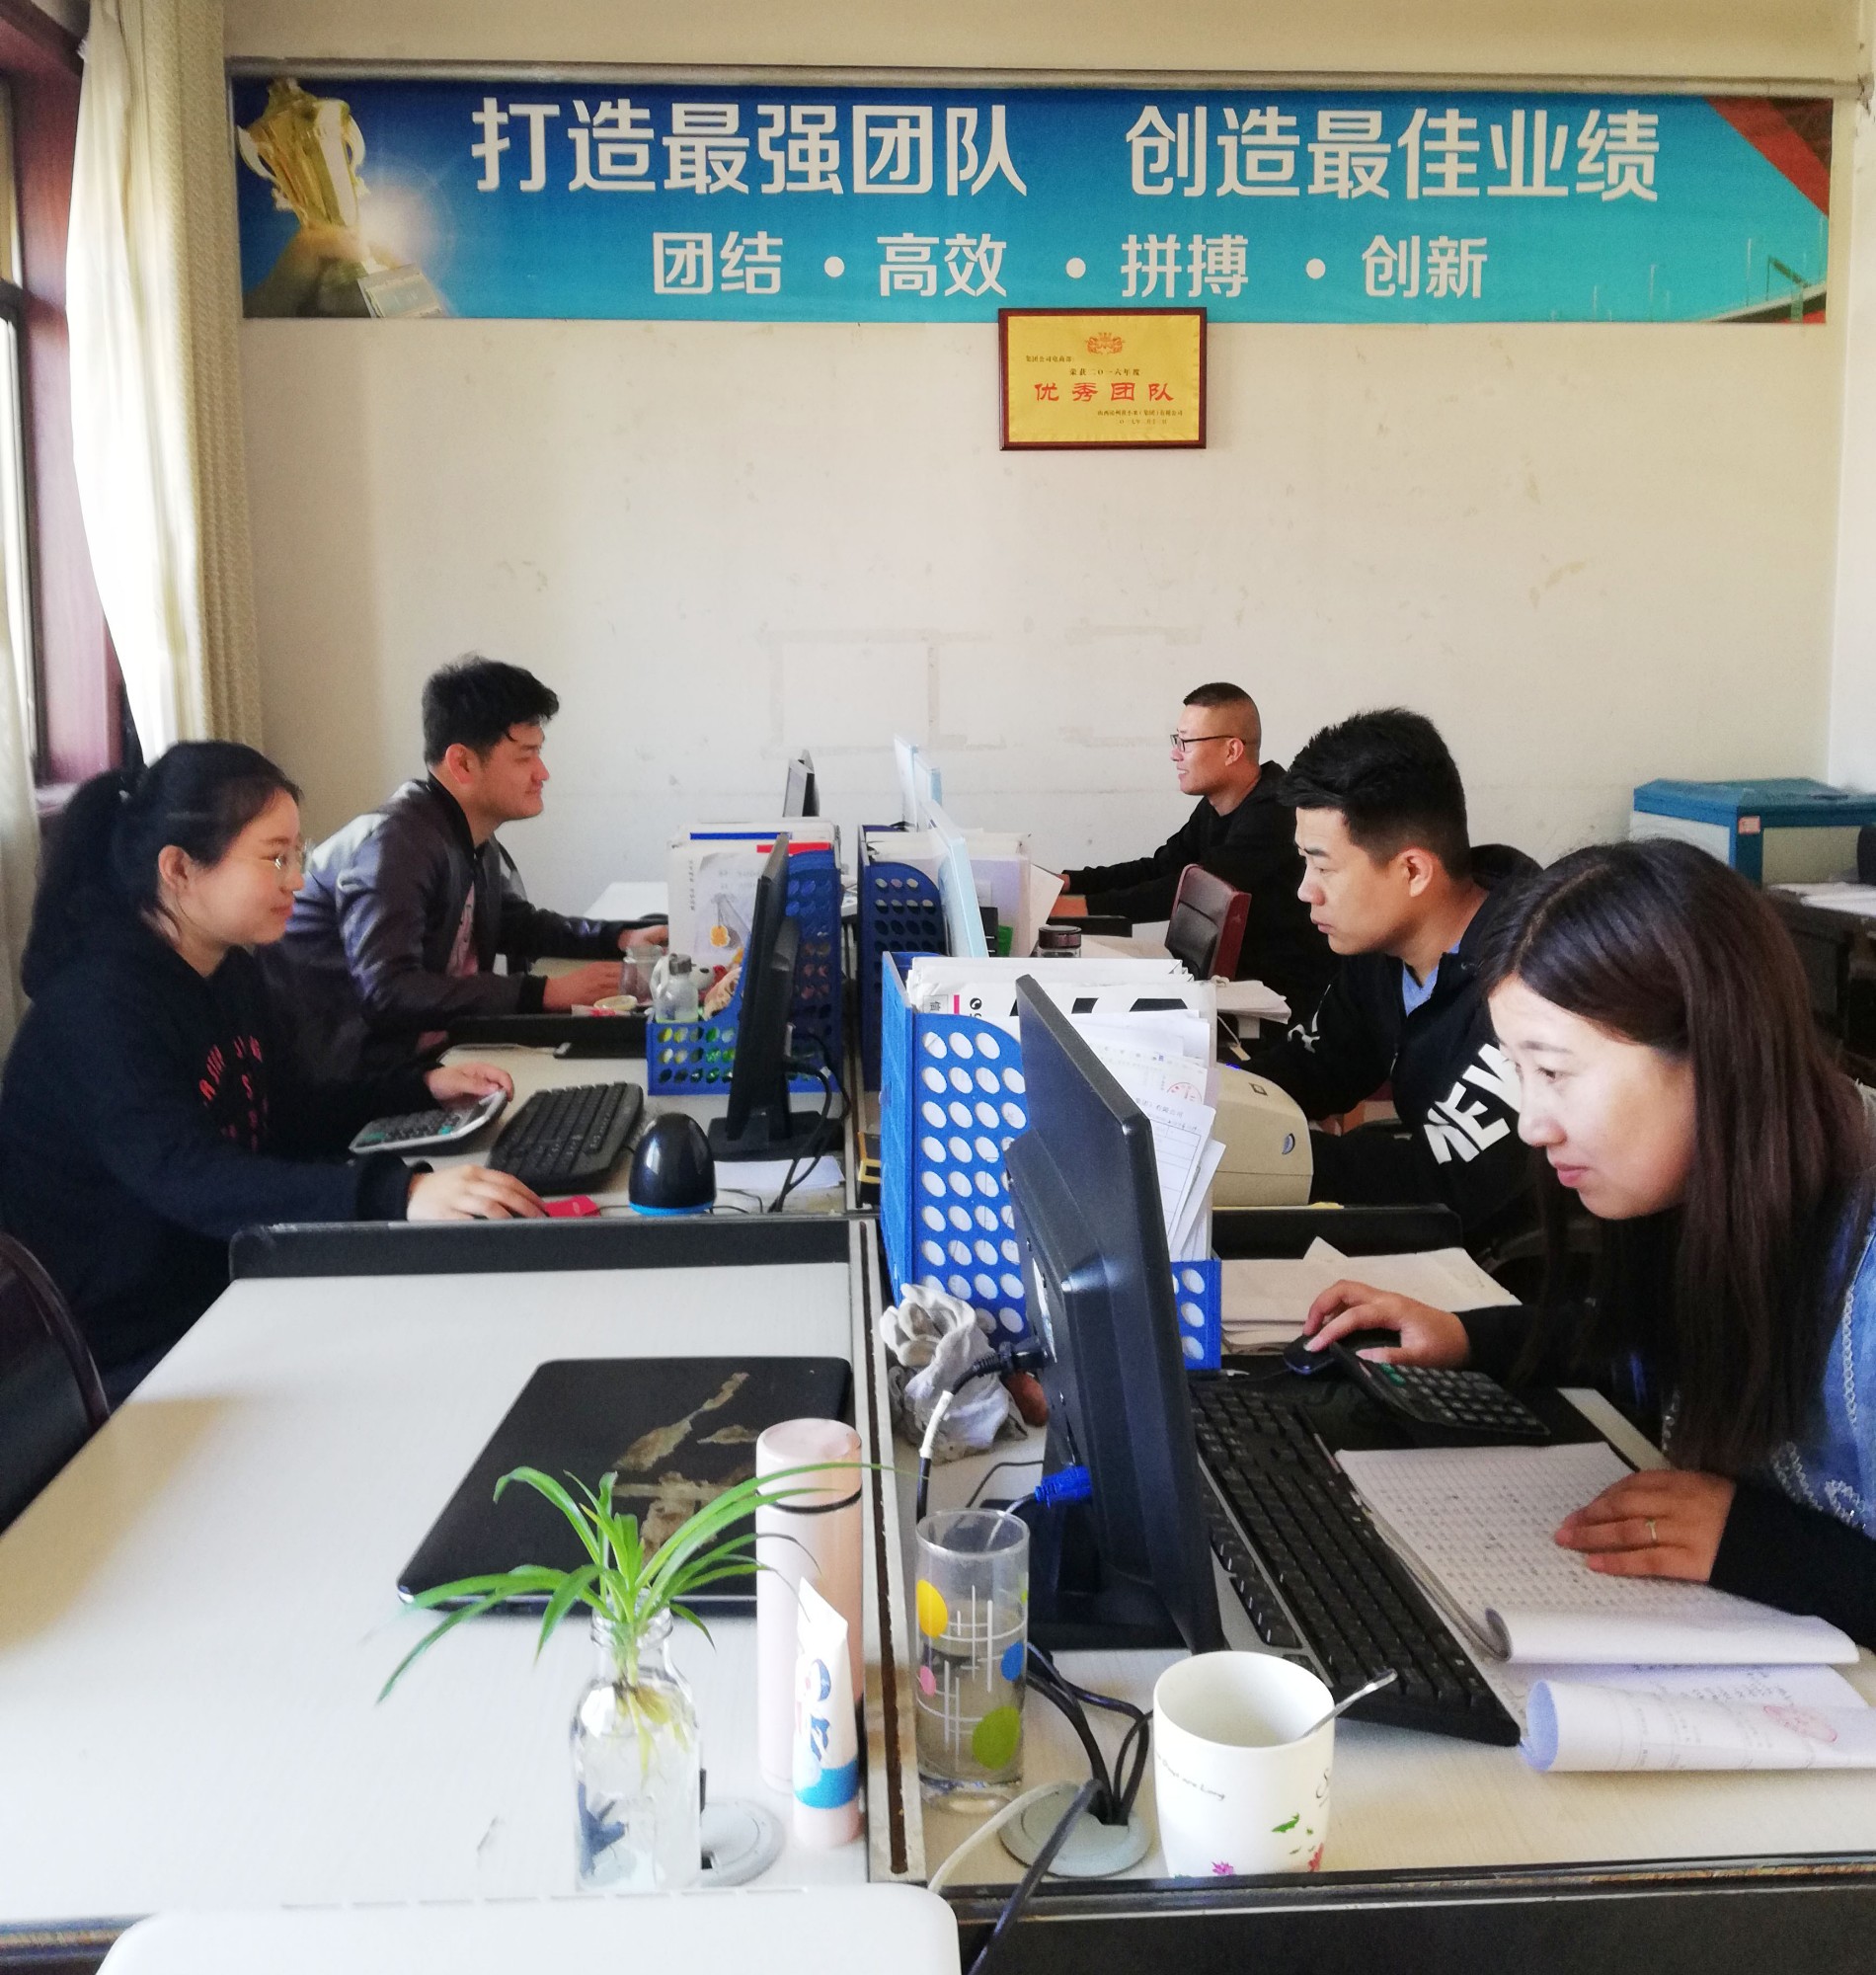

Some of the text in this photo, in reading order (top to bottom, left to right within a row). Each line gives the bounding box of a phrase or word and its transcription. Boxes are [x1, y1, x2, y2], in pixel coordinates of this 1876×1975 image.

[471, 98, 1661, 201] 打造最强团队 创造最佳业绩
[653, 231, 1488, 299] 团结 高效 拼搏 创新
[1034, 382, 1174, 402] 优秀团队
